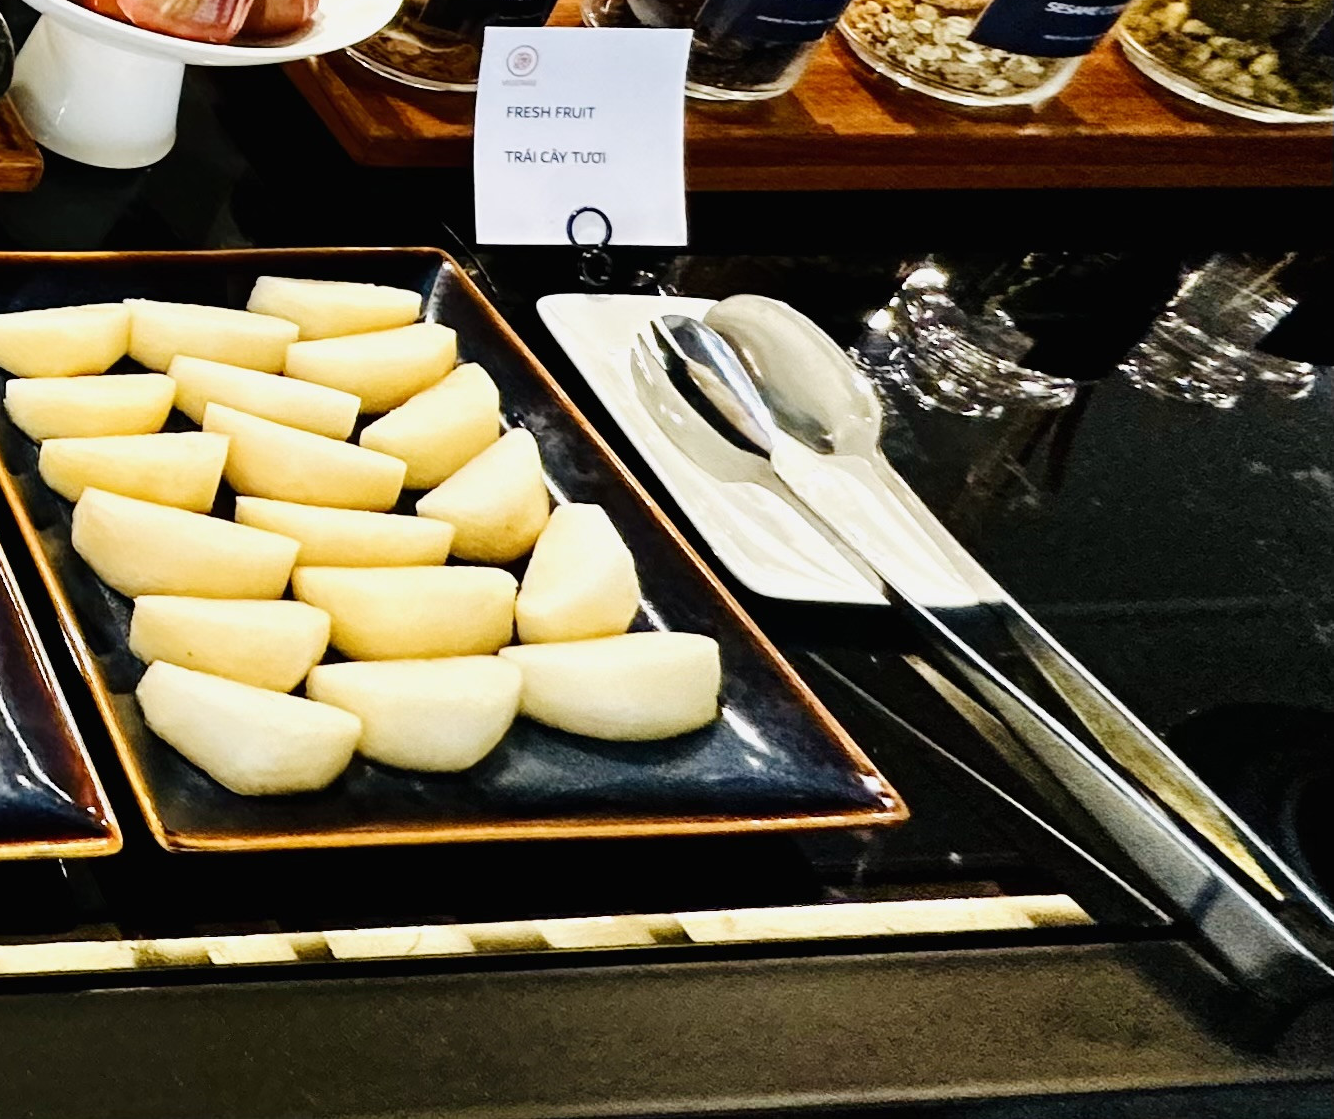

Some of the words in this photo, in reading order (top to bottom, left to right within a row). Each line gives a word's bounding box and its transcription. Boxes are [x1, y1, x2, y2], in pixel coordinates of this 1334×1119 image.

[506, 106, 551, 119] FRESH
[555, 106, 596, 119] FRUIT
[505, 147, 537, 163] TRÁI
[572, 150, 606, 164] TƯƠI
